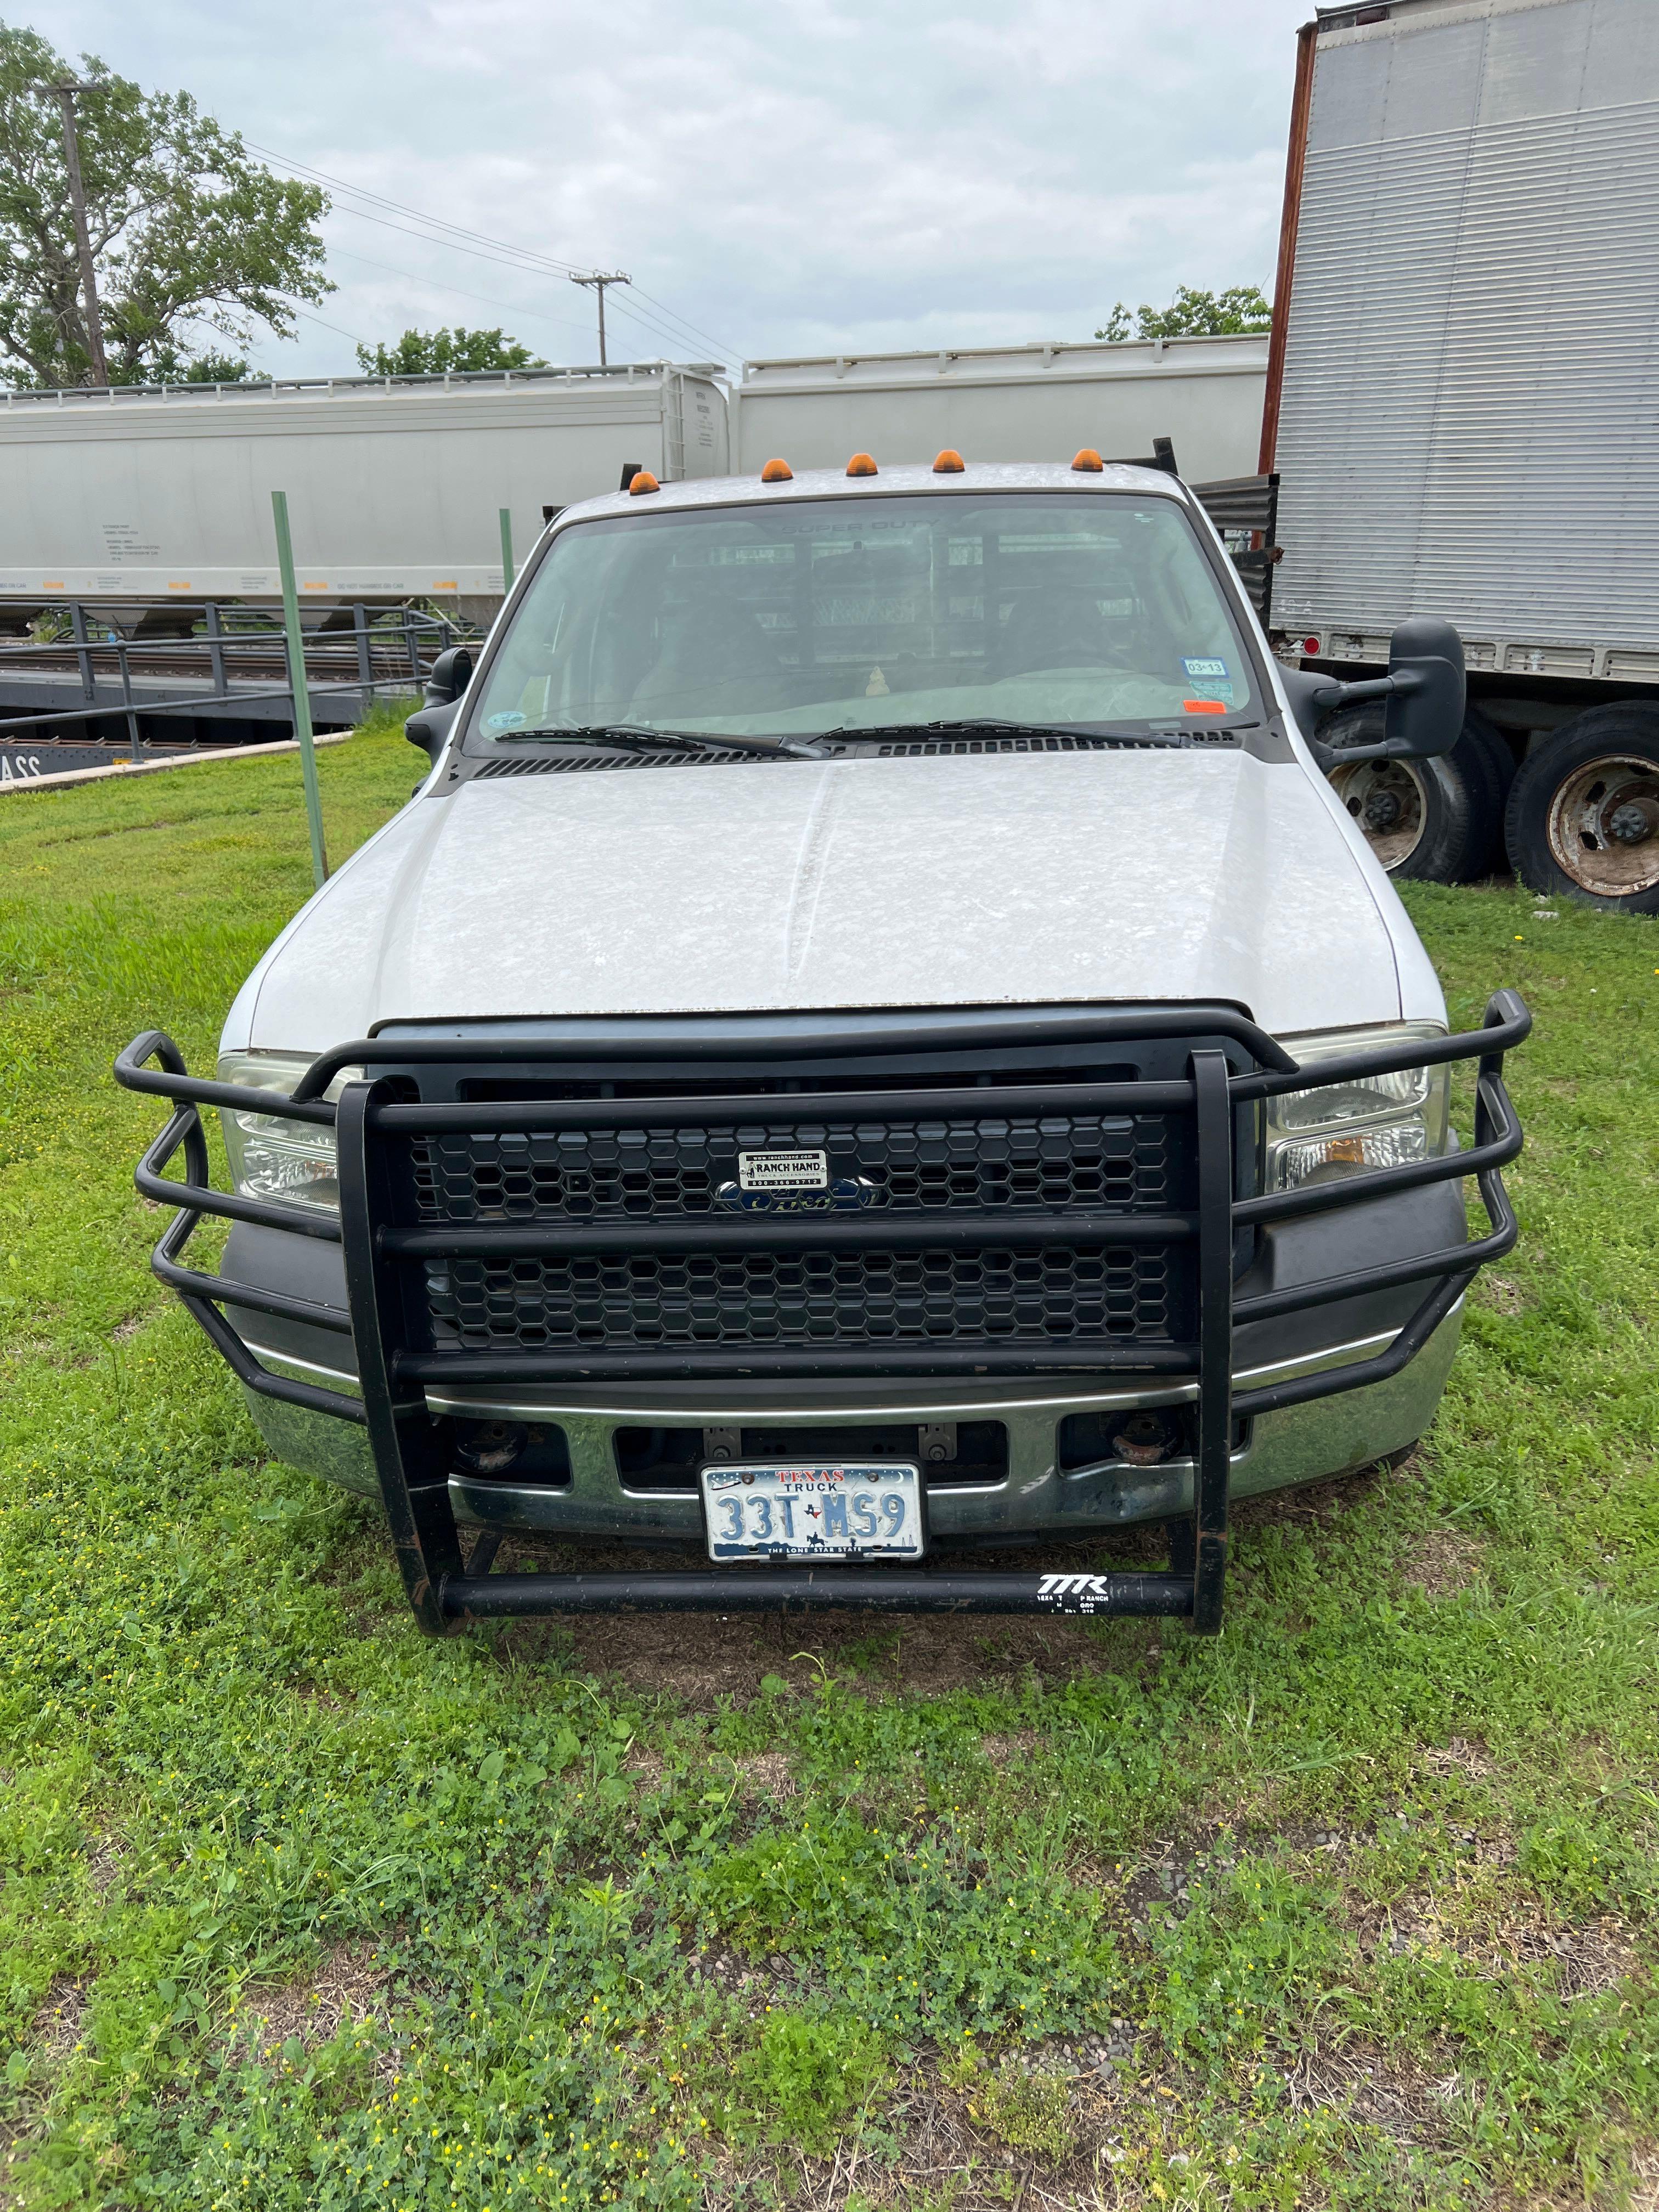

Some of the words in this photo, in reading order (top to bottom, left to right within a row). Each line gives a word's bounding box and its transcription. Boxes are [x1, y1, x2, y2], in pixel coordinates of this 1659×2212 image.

[781, 522, 863, 534] SUPER
[871, 518, 940, 531] DUTY
[757, 1164, 790, 1172] RANCH
[792, 1163, 820, 1171] HAND
[775, 1470, 845, 1483] TEXAS
[785, 1482, 838, 1492] TRUCK
